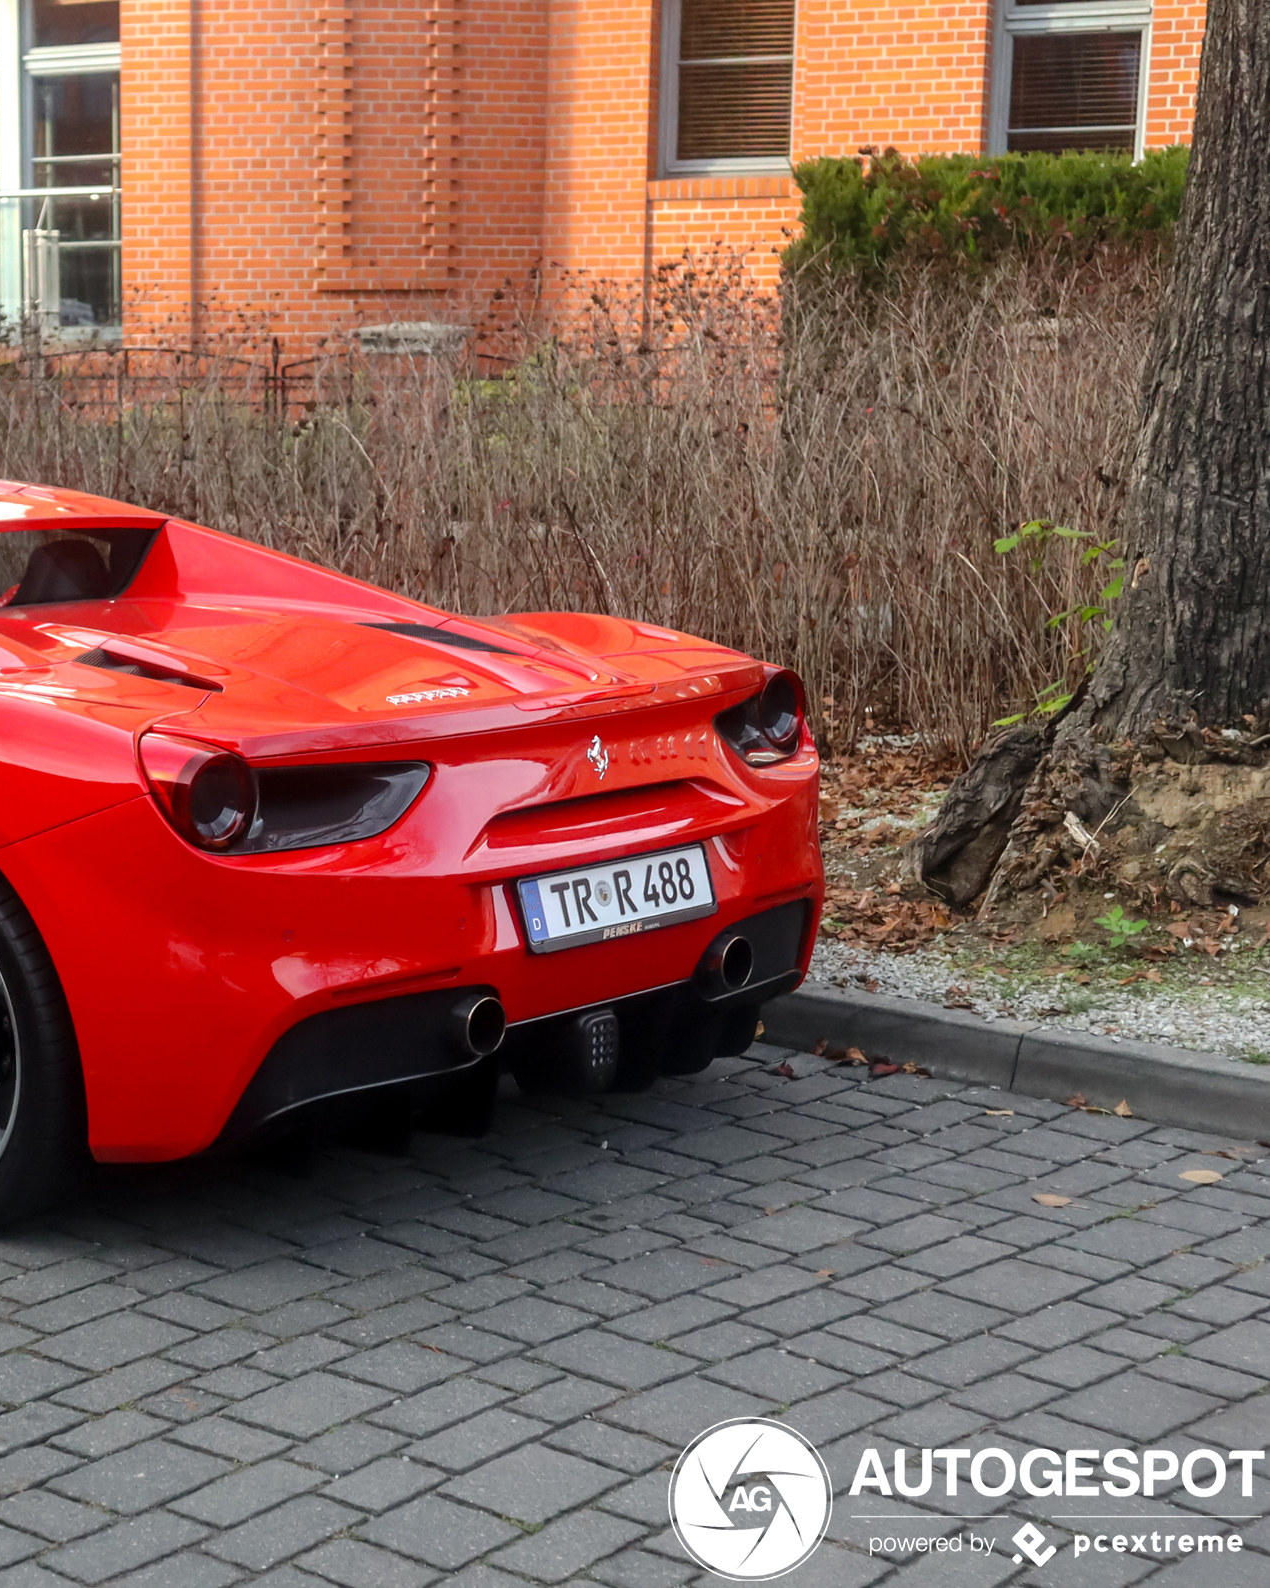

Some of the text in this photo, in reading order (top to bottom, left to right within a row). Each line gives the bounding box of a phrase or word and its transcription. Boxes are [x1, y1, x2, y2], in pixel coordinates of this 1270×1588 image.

[550, 857, 694, 928] TR R 488
[533, 917, 542, 931] D
[603, 921, 643, 940] PENSKE
